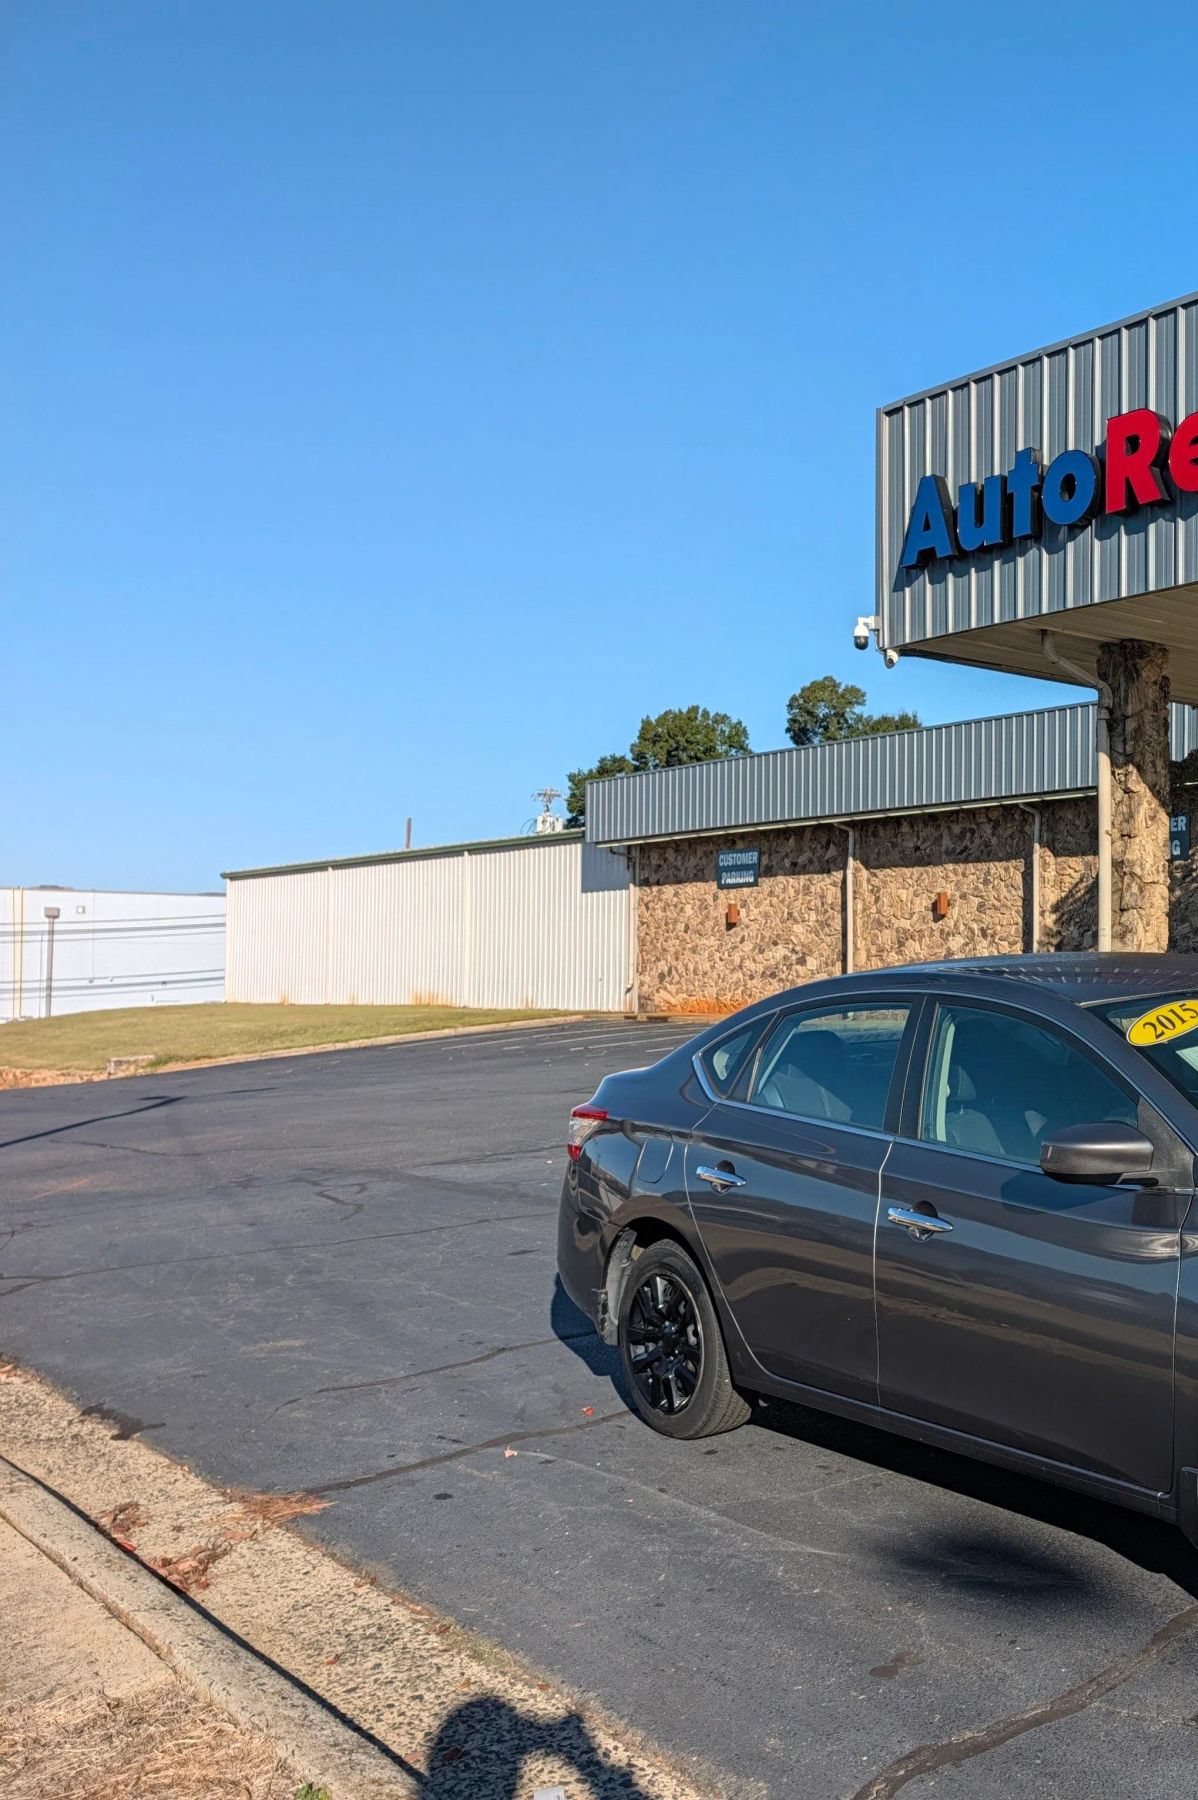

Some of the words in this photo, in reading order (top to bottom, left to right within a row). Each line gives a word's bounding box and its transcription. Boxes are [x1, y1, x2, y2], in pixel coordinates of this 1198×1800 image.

[719, 851, 758, 866] CUSTOMER
[721, 870, 754, 884] PARKING
[1142, 1003, 1198, 1040] 2015
